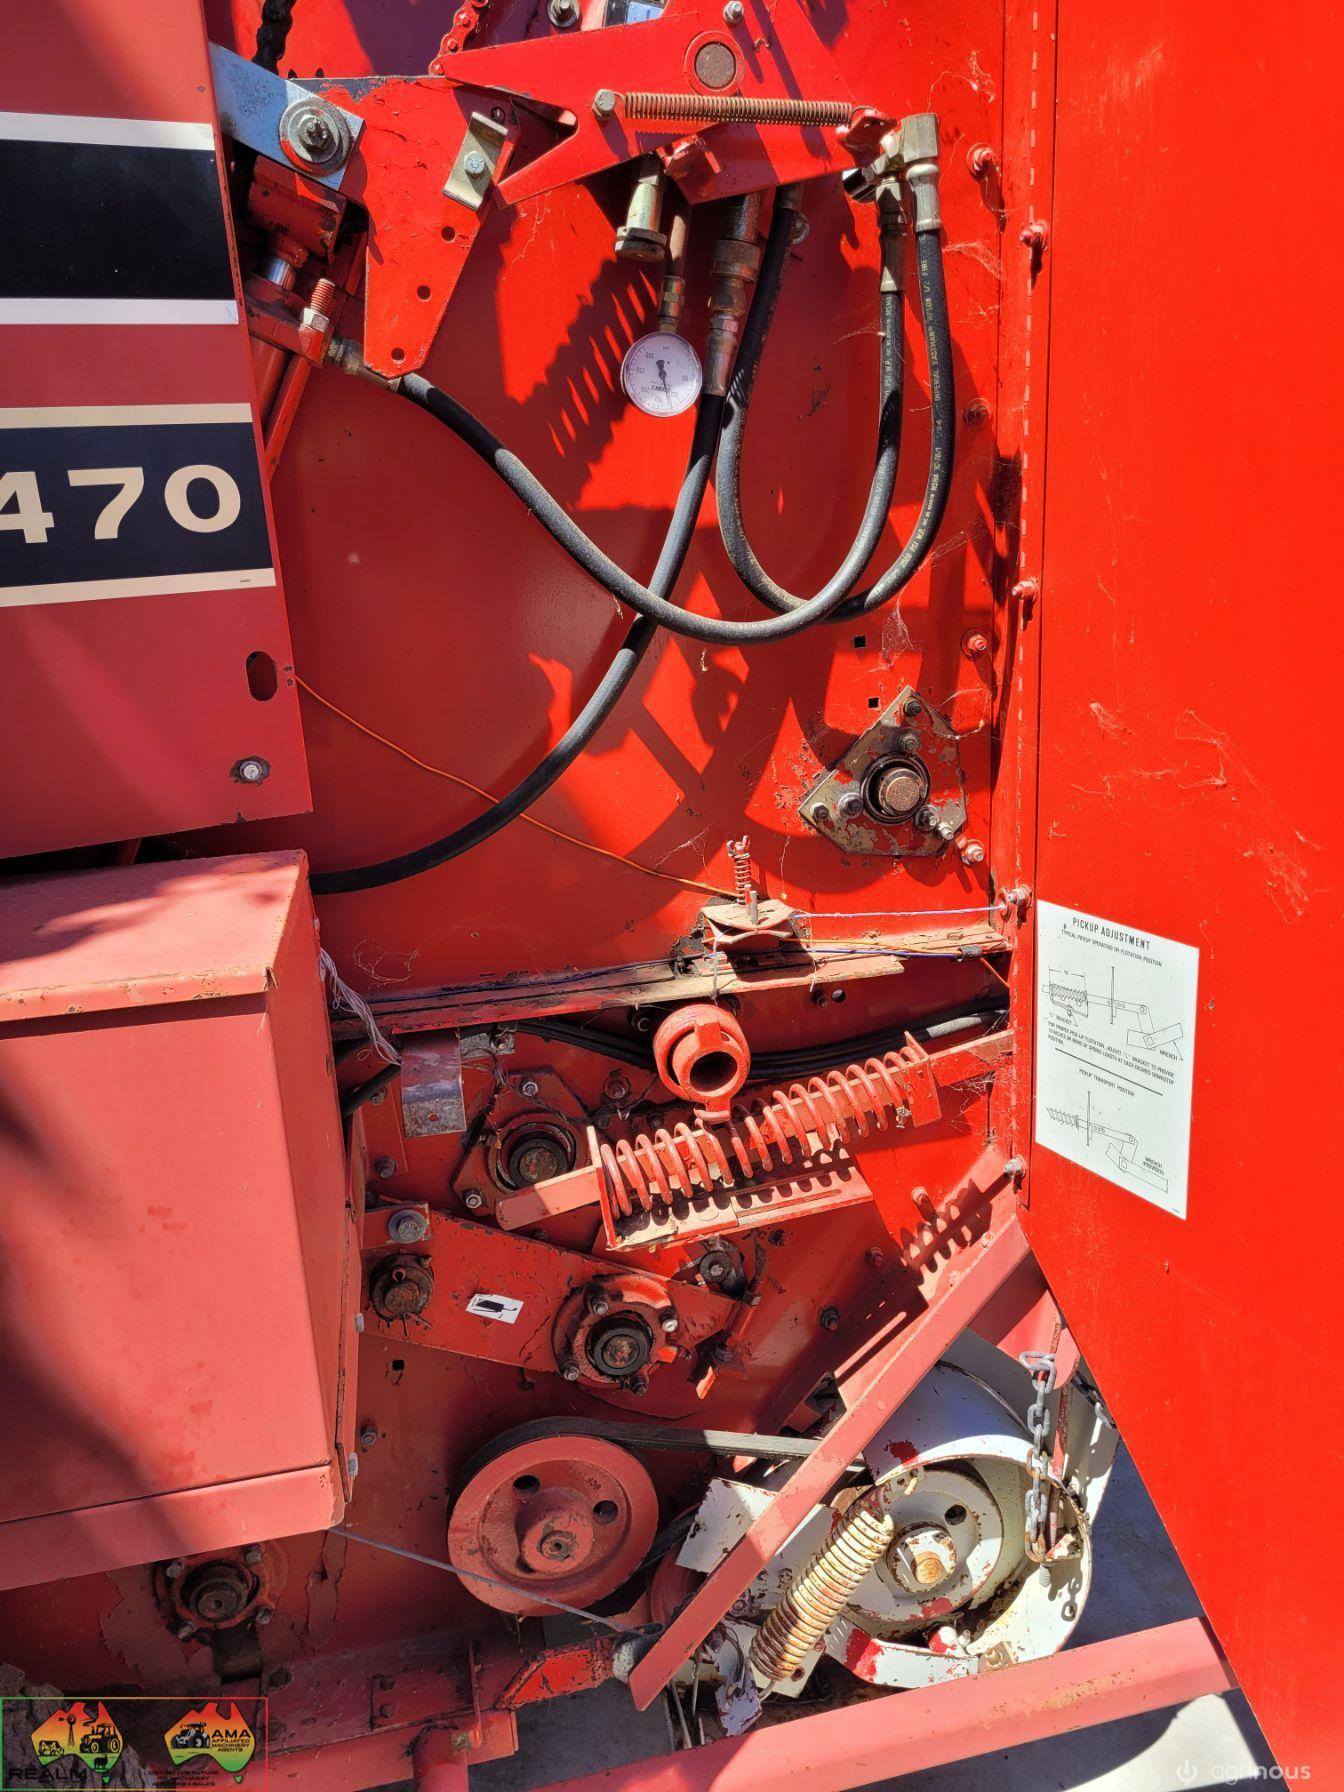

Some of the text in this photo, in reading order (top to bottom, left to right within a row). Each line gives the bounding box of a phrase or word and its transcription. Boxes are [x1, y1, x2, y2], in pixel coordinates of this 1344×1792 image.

[0, 464, 241, 544] 470
[1072, 916, 1151, 950] PICKUP ADJUSTMENT
[1092, 939, 1113, 950] OPERATING
[1143, 956, 1162, 967] POSITION
